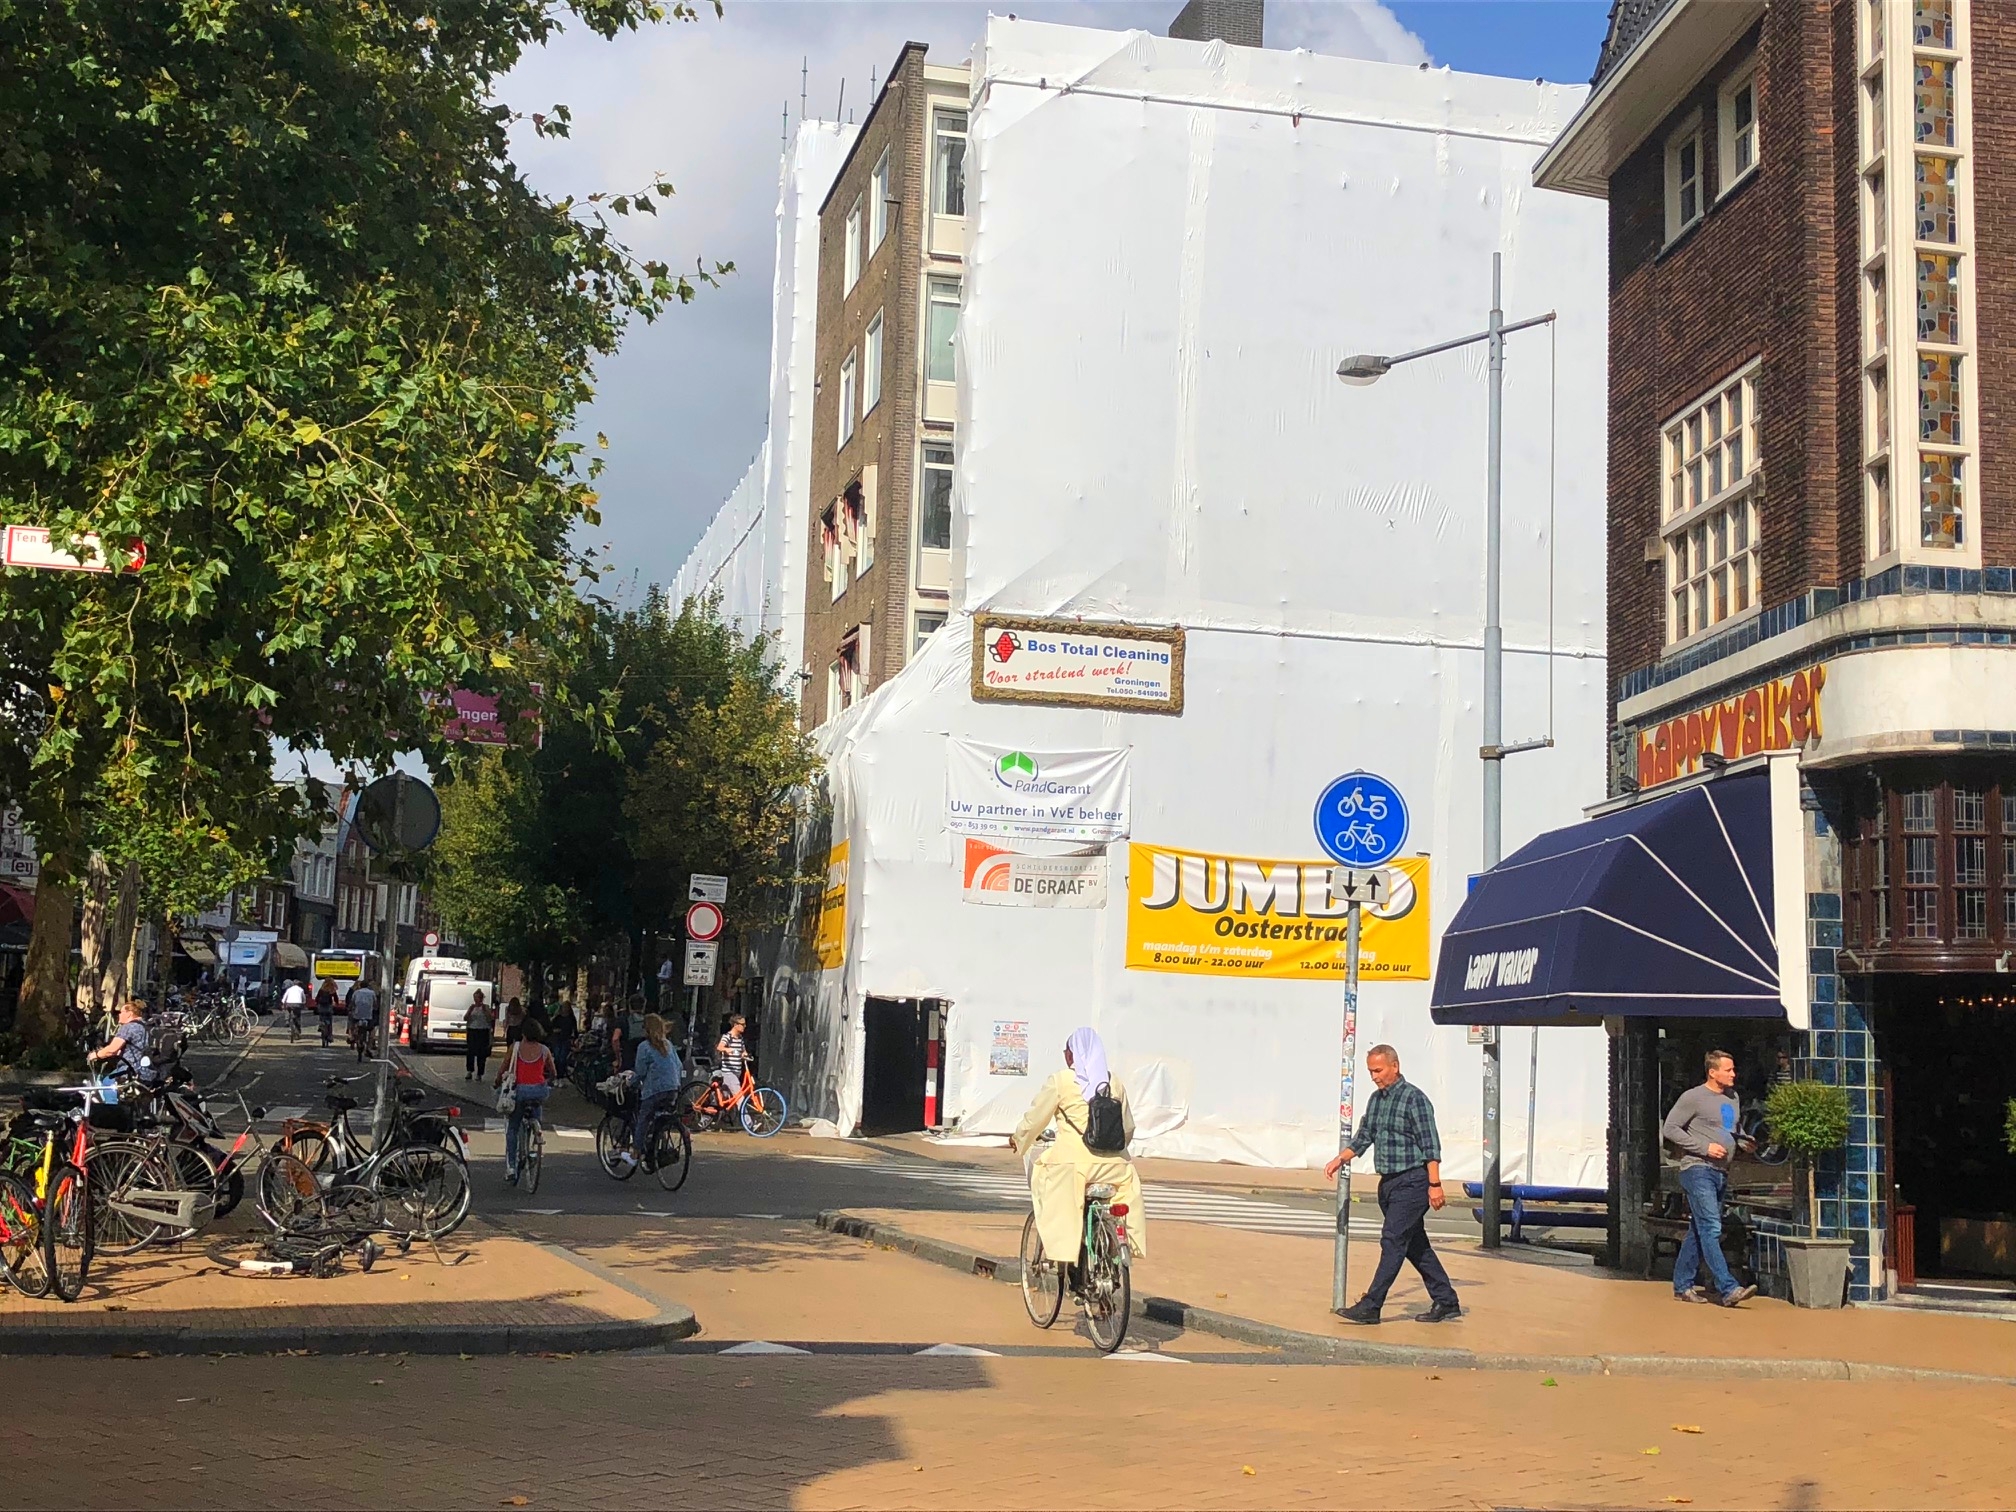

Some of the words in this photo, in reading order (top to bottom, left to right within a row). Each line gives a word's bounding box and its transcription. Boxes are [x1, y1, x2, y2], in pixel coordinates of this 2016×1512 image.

[15, 532, 37, 543] Ten
[1027, 639, 1057, 654] Bos
[1061, 641, 1098, 657] Total
[1103, 645, 1170, 664] Cleaning
[986, 669, 1019, 685] Voor
[1025, 665, 1086, 681] stralend
[1092, 661, 1133, 676] werk!
[1114, 676, 1161, 688] Groningen
[1014, 779, 1091, 795] PandGarant
[950, 800, 973, 813] Uw
[977, 804, 1028, 817] partner
[1032, 805, 1045, 818] in
[1050, 807, 1075, 819] VvE
[1079, 807, 1123, 821] beheer
[1014, 825, 1075, 835] www.pandgarant.nl
[1014, 877, 1034, 894] DE
[1037, 879, 1085, 895] GRAAF
[1088, 879, 1098, 887] BV
[1143, 941, 1197, 956] maandag
[1199, 943, 1221, 955] t/m
[1223, 946, 1273, 960] zaterdag
[1153, 952, 1180, 964] 8.00
[1182, 956, 1202, 966] uur
[1211, 958, 1243, 968] 22.00
[1245, 960, 1264, 969] uur
[1300, 961, 1329, 970] 12.00
[1358, 962, 1390, 972] 22.00
[1392, 963, 1412, 972] uur
